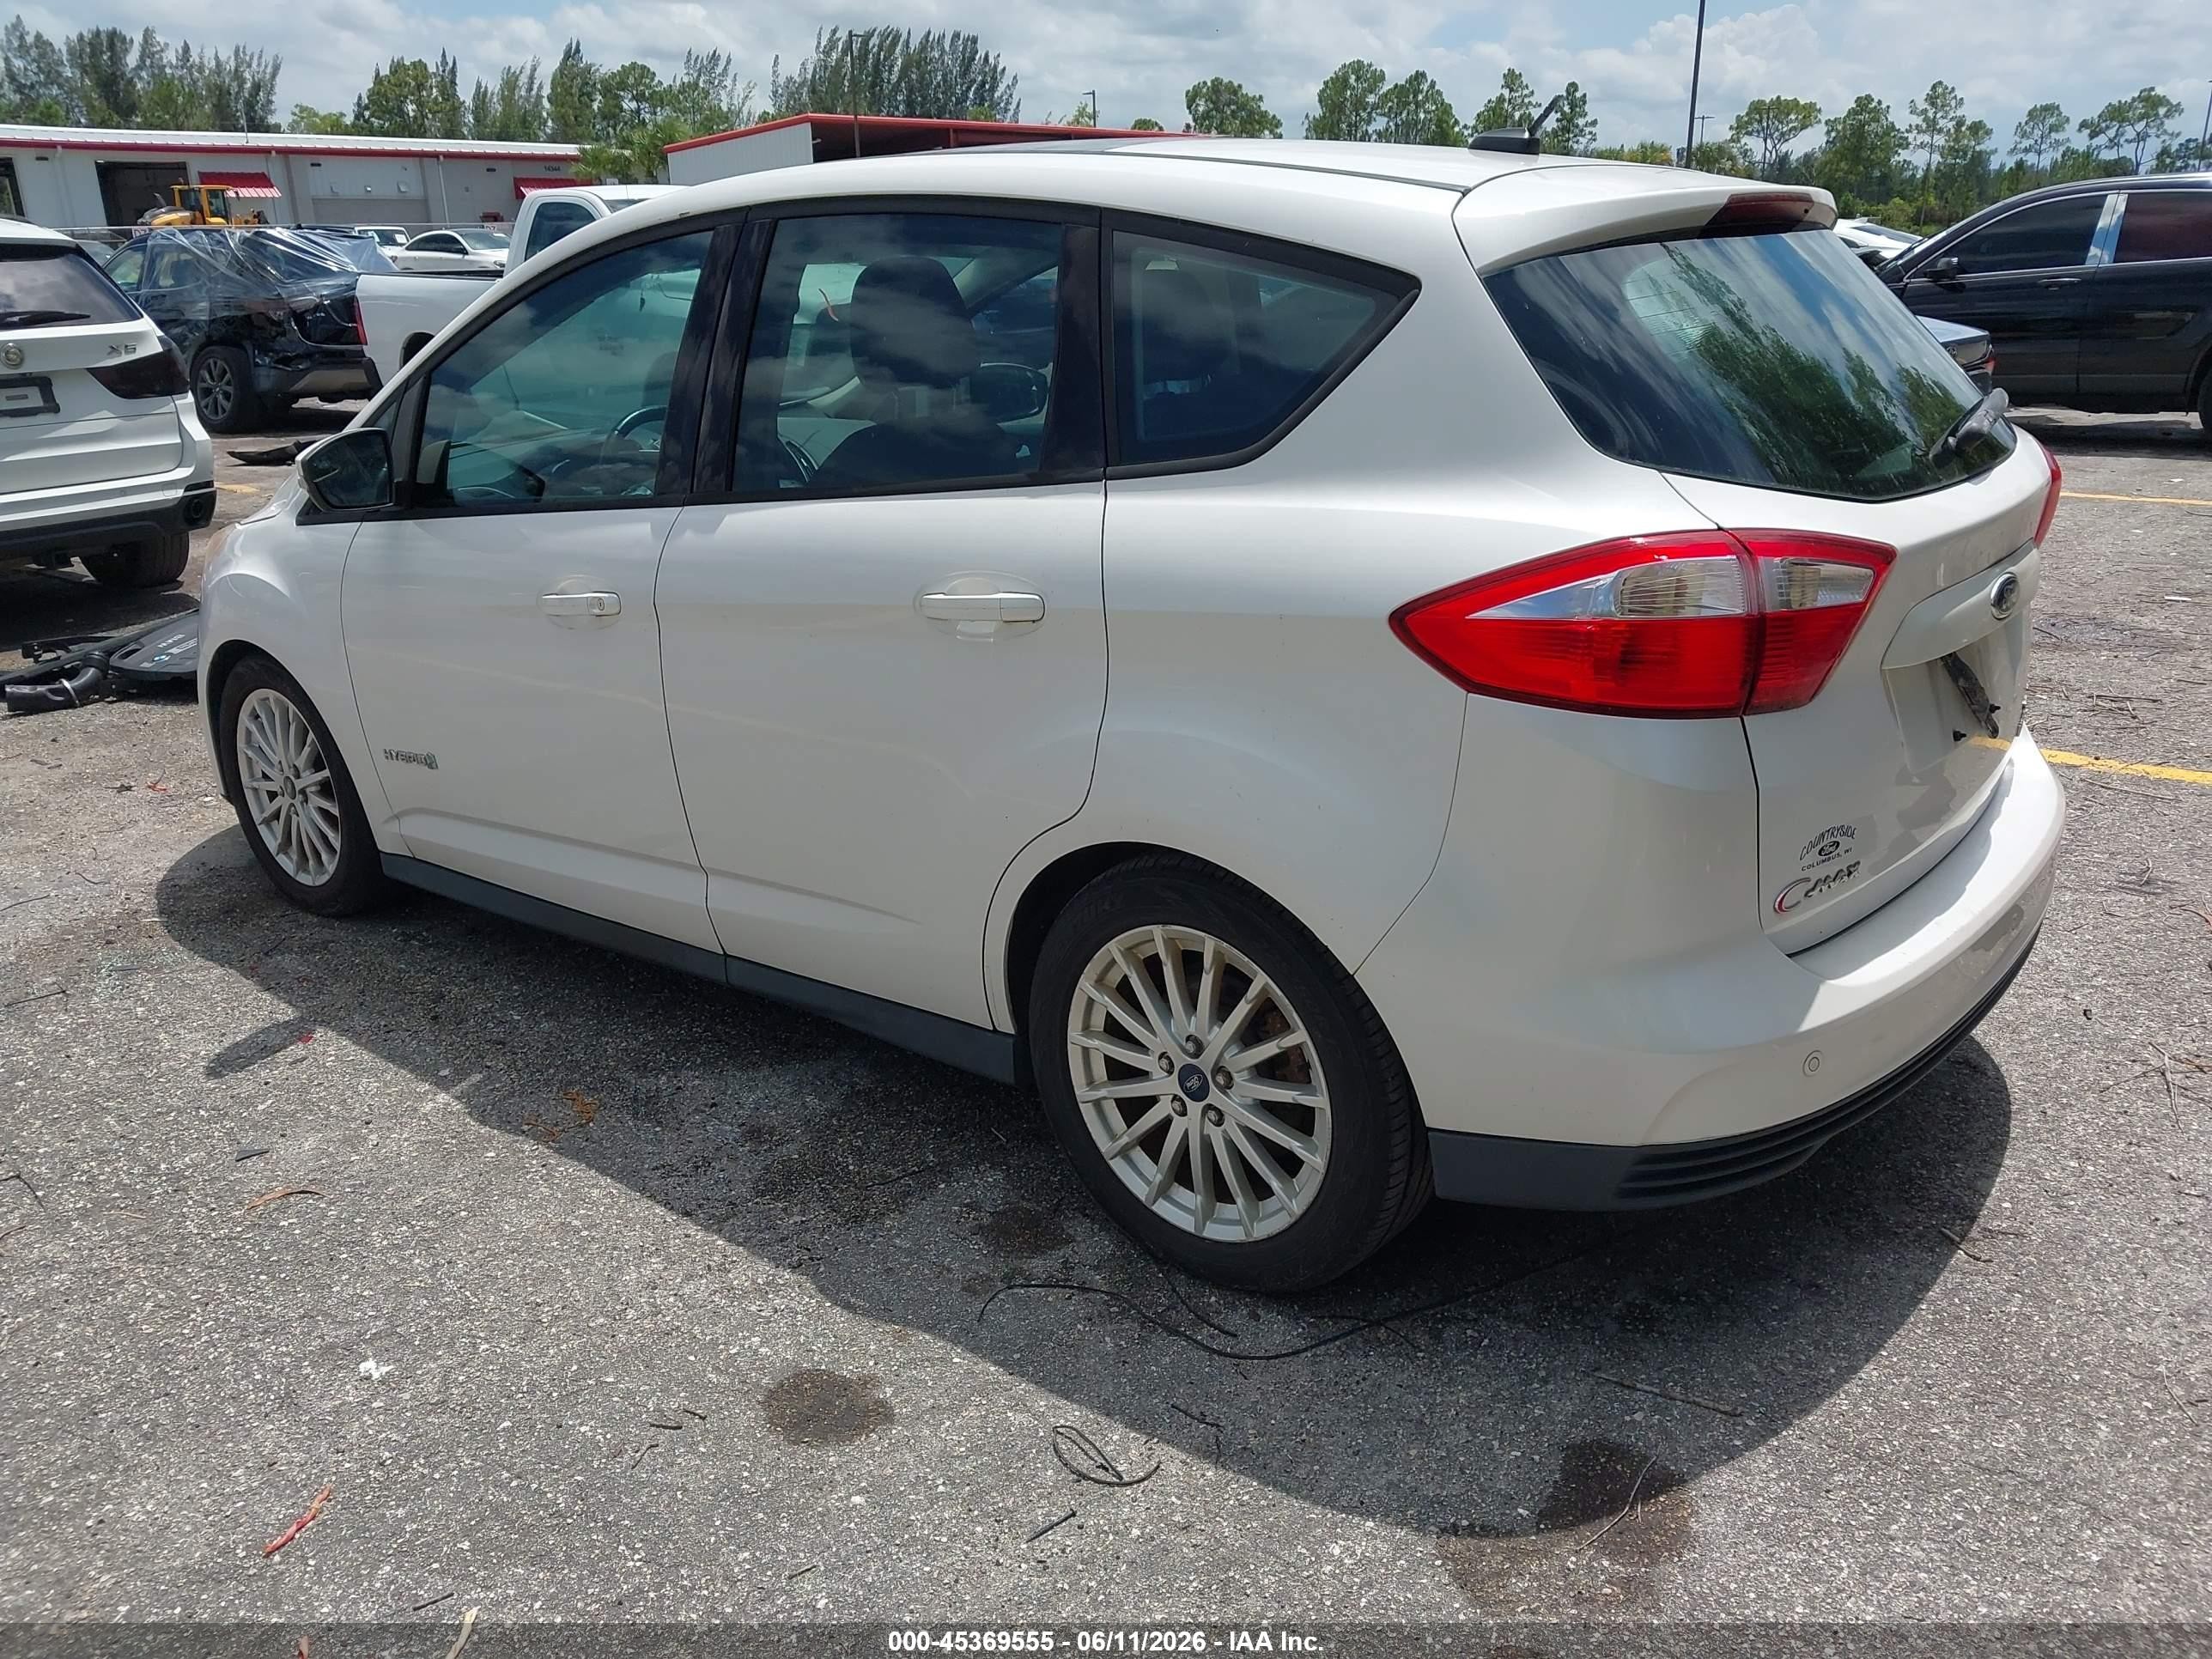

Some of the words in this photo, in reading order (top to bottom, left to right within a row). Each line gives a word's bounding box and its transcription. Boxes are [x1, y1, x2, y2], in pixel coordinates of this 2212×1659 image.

[383, 748, 428, 766] HYBRID
[1800, 824, 1856, 860] COUNTRYSIDE
[1802, 852, 1842, 872] COLUMBUS,
